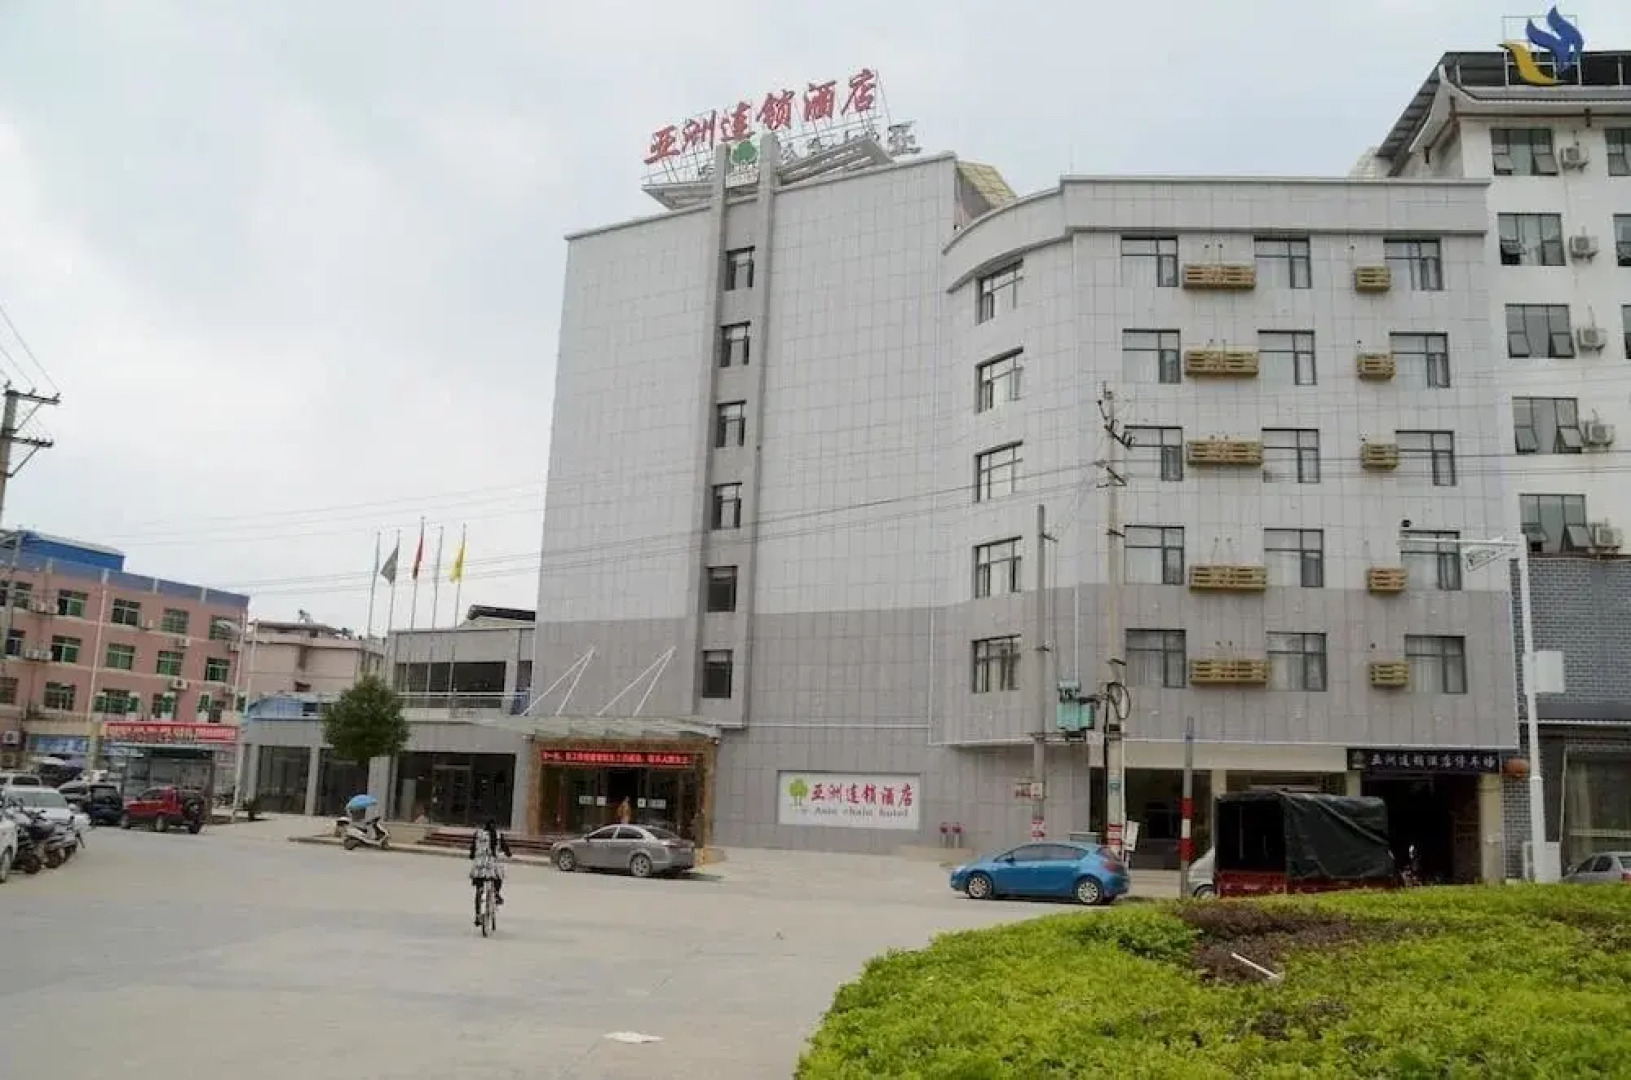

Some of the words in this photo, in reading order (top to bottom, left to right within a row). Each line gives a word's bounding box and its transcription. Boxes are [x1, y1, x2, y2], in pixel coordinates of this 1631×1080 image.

[644, 68, 876, 165] 亚洲连锁酒店
[811, 783, 913, 807] 亚洲连锁酒店
